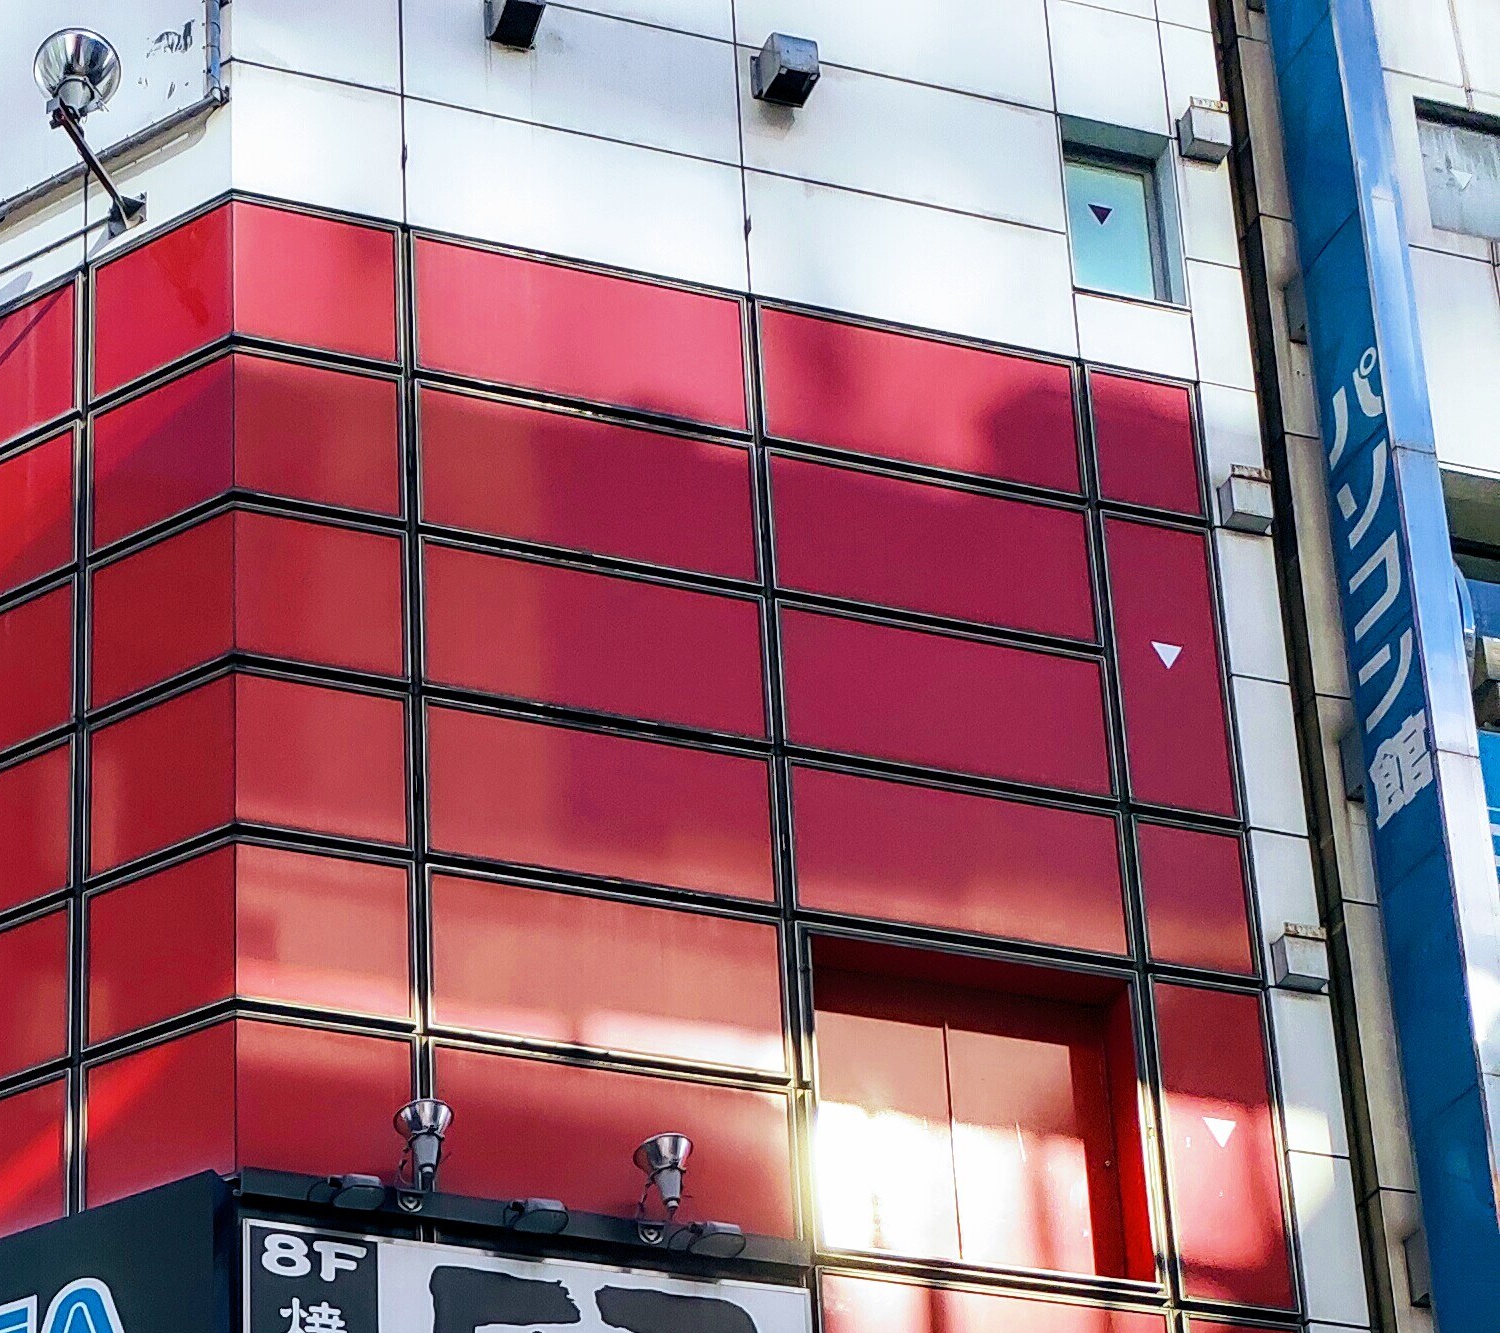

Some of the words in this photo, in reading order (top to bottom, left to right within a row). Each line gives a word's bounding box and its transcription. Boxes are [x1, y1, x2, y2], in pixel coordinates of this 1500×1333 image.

[1329, 346, 1433, 830] パソコン館
[261, 1233, 368, 1282] 8F
